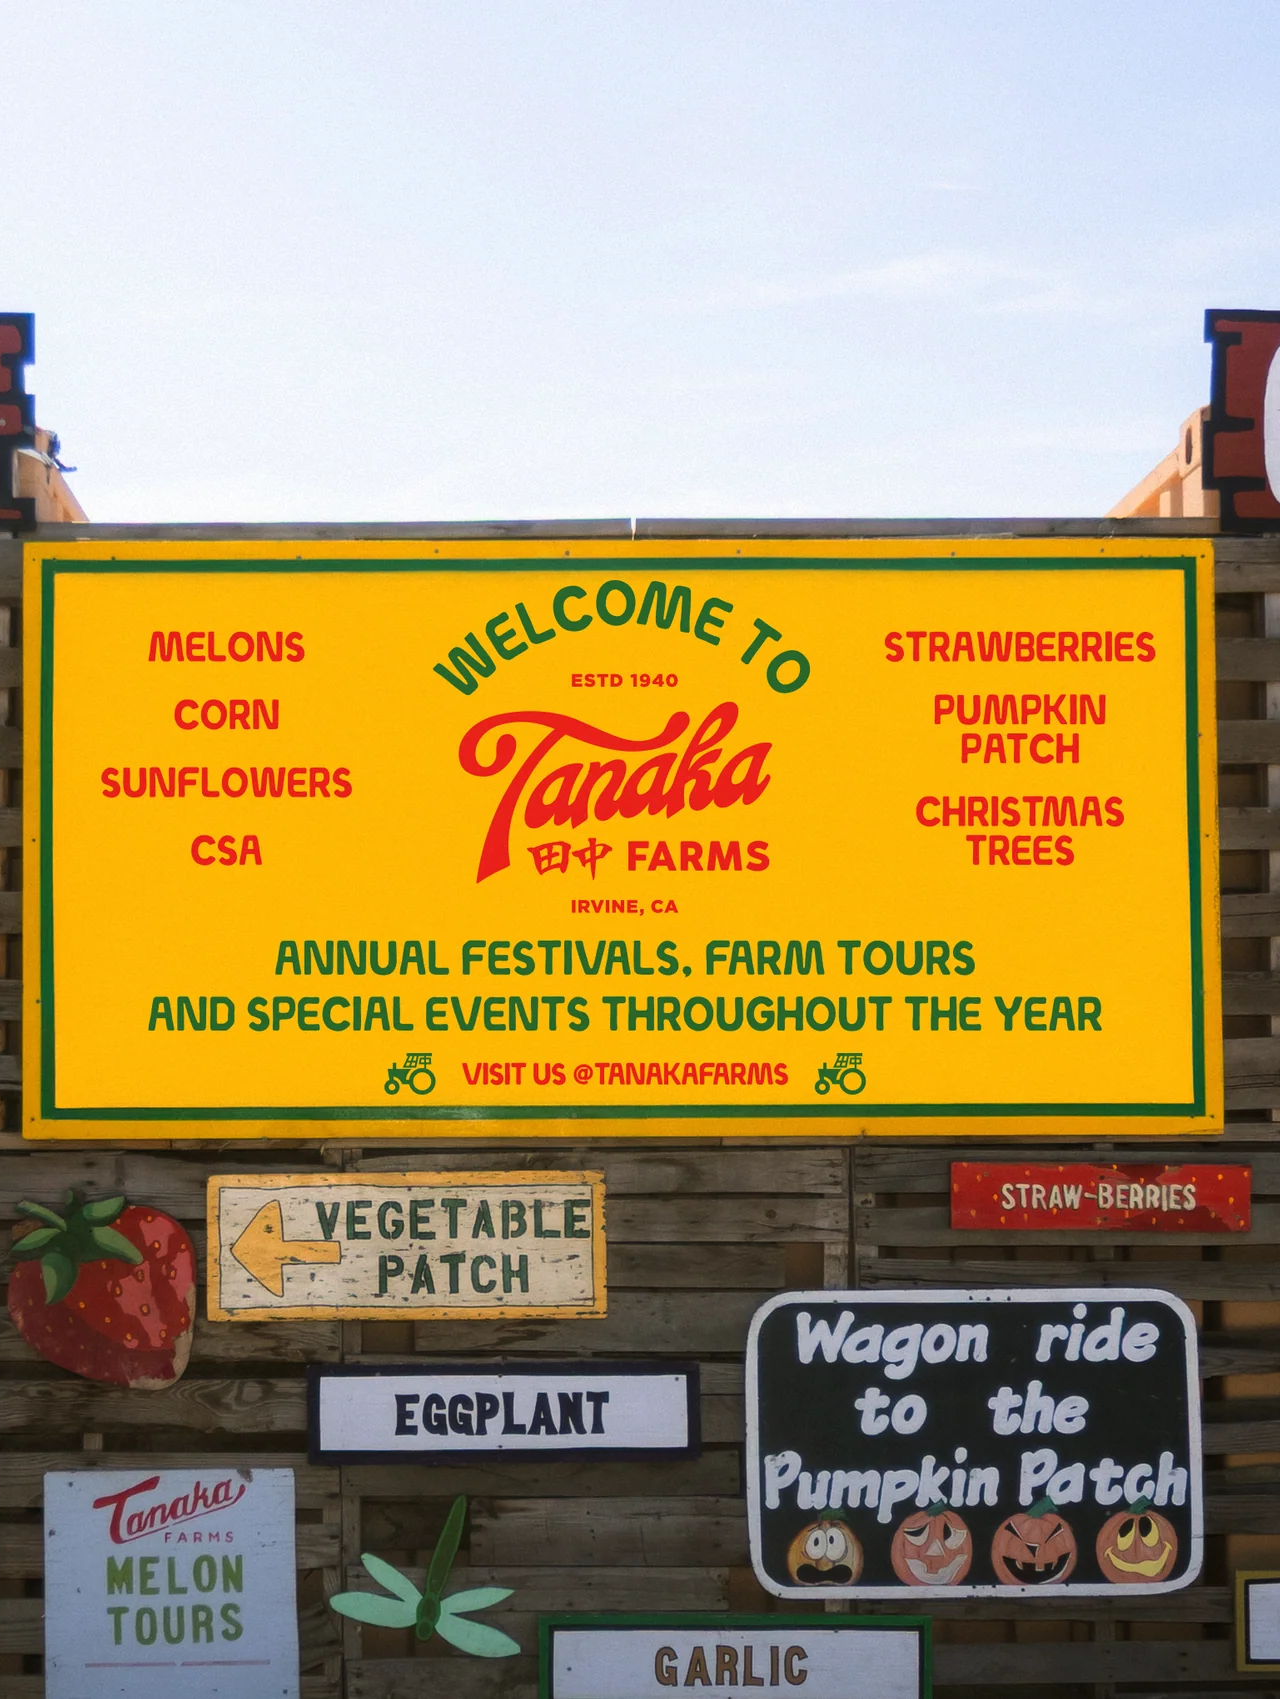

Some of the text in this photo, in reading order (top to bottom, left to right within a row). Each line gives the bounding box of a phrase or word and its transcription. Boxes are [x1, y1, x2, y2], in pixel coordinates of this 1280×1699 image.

[148, 631, 305, 662] MELONS
[433, 580, 811, 695] WELCOME TO
[884, 631, 1156, 662] STRAWBERRIES
[571, 674, 678, 688] ESTD 1940
[174, 699, 279, 730] CORN
[934, 694, 1106, 725] PUMPKIN
[961, 733, 1079, 764] PATCH
[101, 767, 352, 798] SUNFLOWERS
[458, 701, 772, 883] Tanaka
[916, 796, 1124, 827] CHRISTMAS
[191, 835, 262, 866] CSA
[527, 837, 613, 880] 田中
[628, 840, 770, 872] FARMS
[966, 835, 1074, 866] TREES
[571, 900, 678, 916] IRVINE, CA
[275, 940, 975, 978] ANNUAL FESTIVALS, FARM TOURS
[148, 996, 1102, 1031] AND SPECIAL EVENTS THROUGHOUT THE YEAR
[462, 1062, 789, 1086] VISIT US @TANAKAFARMS
[1001, 1183, 1196, 1211] STRAW-BERRIES
[315, 1199, 591, 1240] VEGETABLE
[379, 1254, 529, 1295] PATCH
[796, 1304, 1160, 1380] Wagon ride
[394, 1391, 609, 1436] EGGPLANT
[854, 1380, 1089, 1436] to the
[764, 1447, 1188, 1524] Pumpkin Patch
[93, 1475, 245, 1544] Tanaka
[164, 1531, 233, 1543] FARMS
[107, 1554, 243, 1596] MELON
[107, 1603, 243, 1646] TOURS
[654, 1645, 808, 1687] GARLIC
